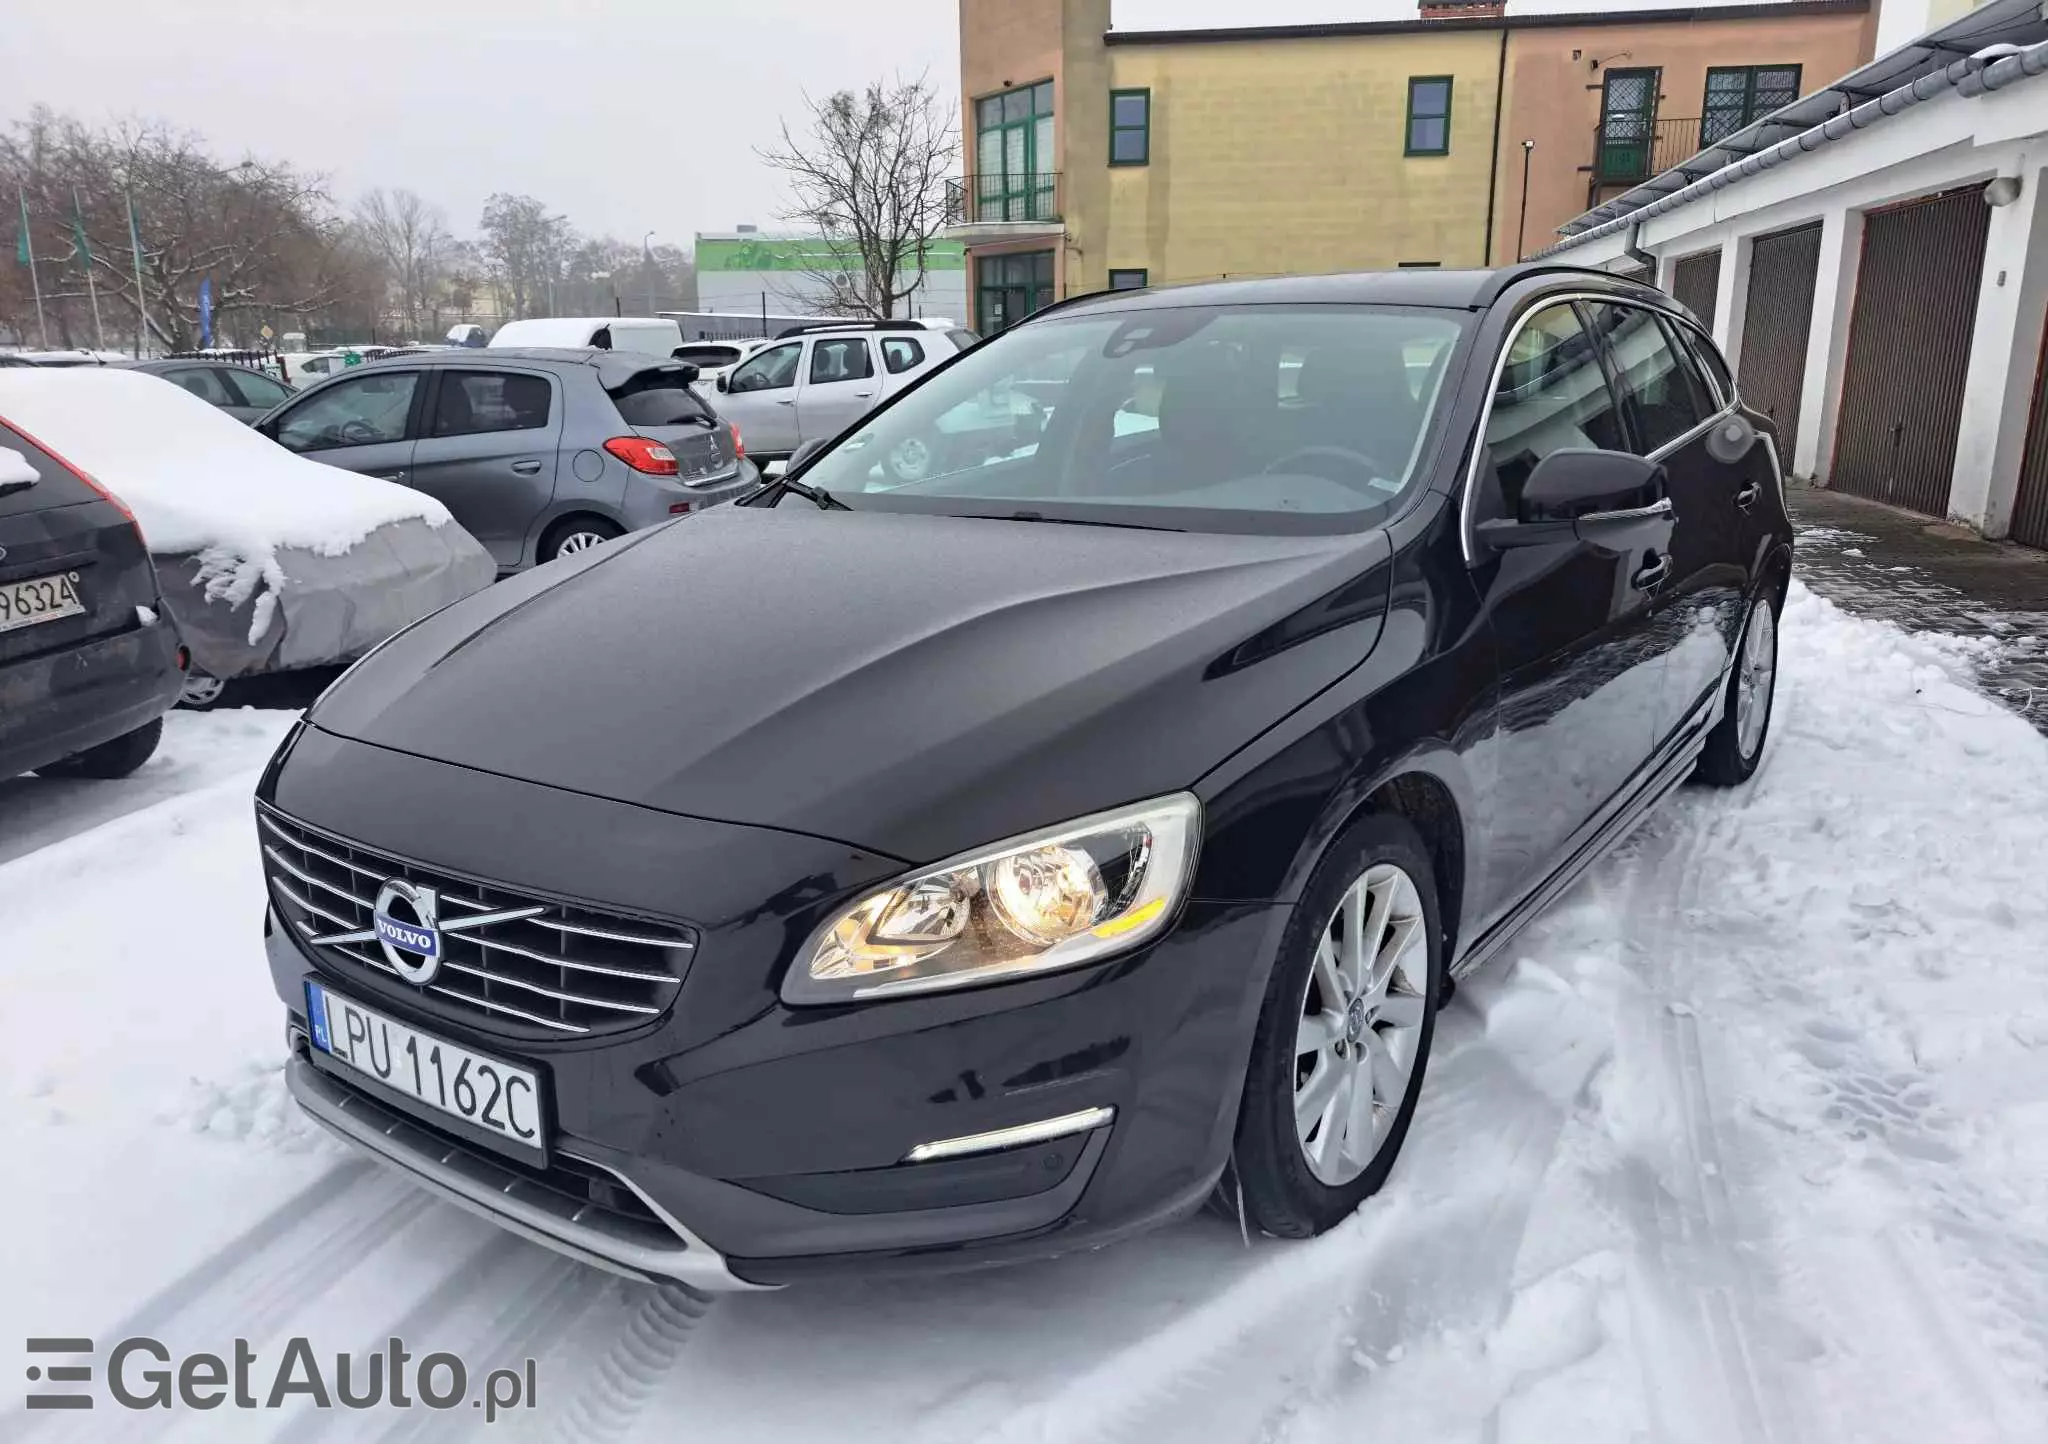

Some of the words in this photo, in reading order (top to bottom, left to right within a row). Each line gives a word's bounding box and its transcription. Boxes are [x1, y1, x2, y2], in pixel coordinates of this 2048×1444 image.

[377, 919, 431, 948] VOLVO
[325, 995, 391, 1079] LPU
[406, 1035, 535, 1139] 1162C
